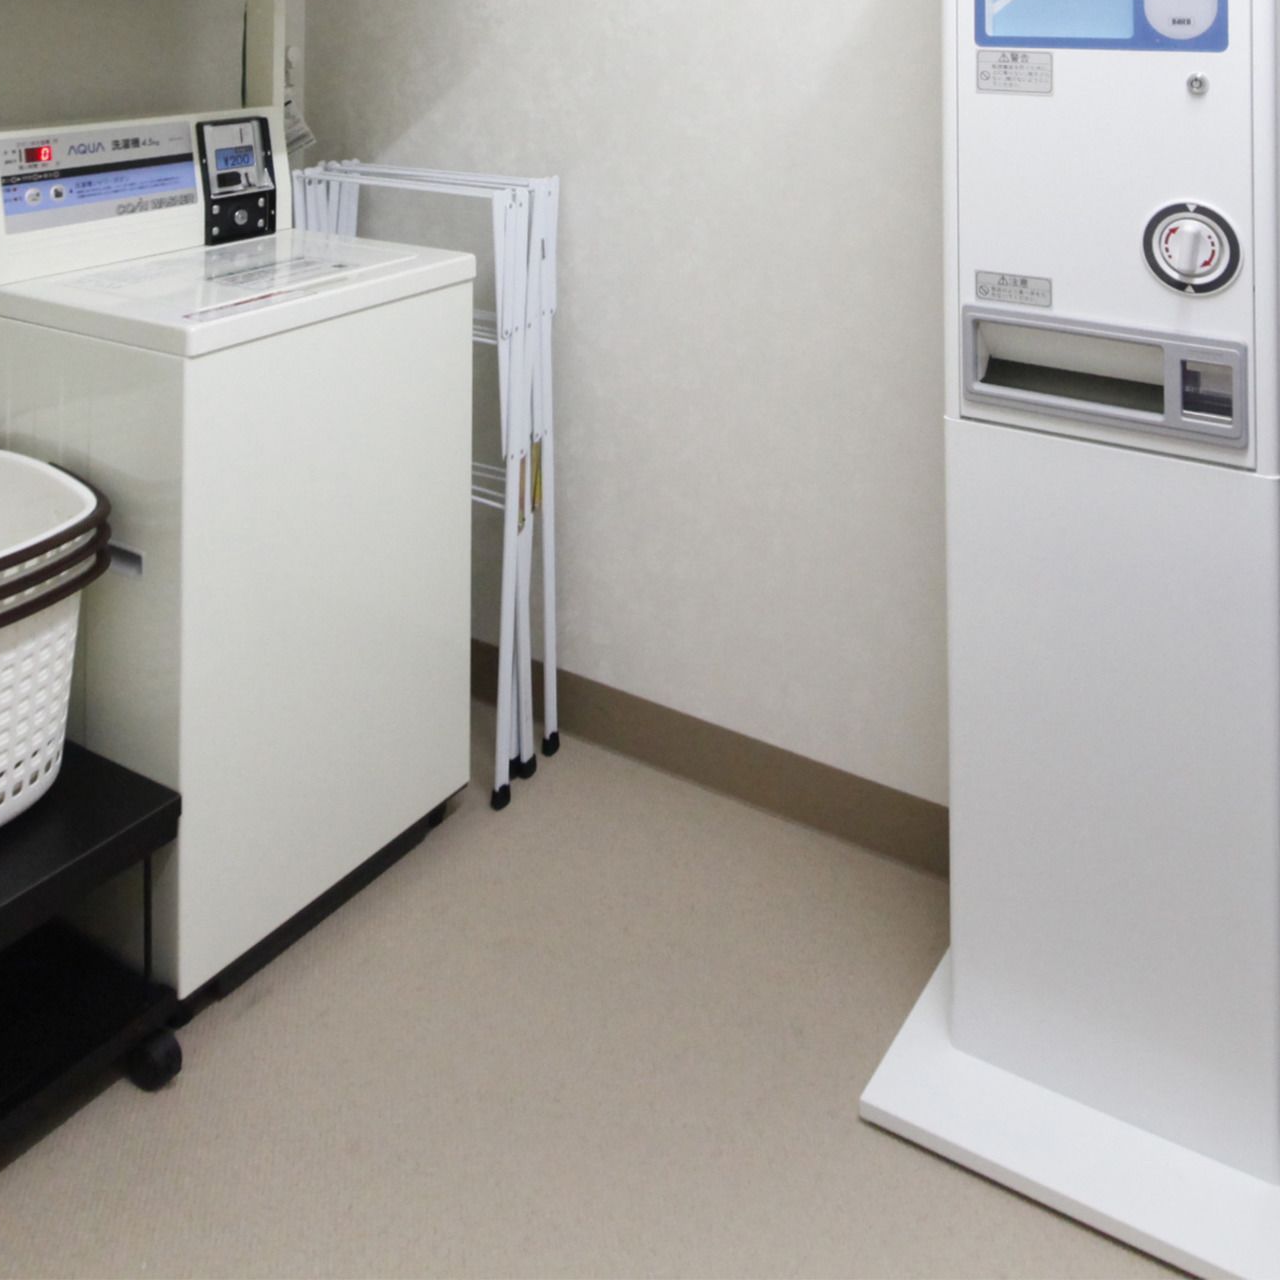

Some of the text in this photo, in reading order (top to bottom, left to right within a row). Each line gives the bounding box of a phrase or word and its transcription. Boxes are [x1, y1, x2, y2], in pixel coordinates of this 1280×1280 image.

[40, 147, 50, 161] 0
[68, 141, 105, 156] AQUA
[223, 153, 250, 167] ¥200
